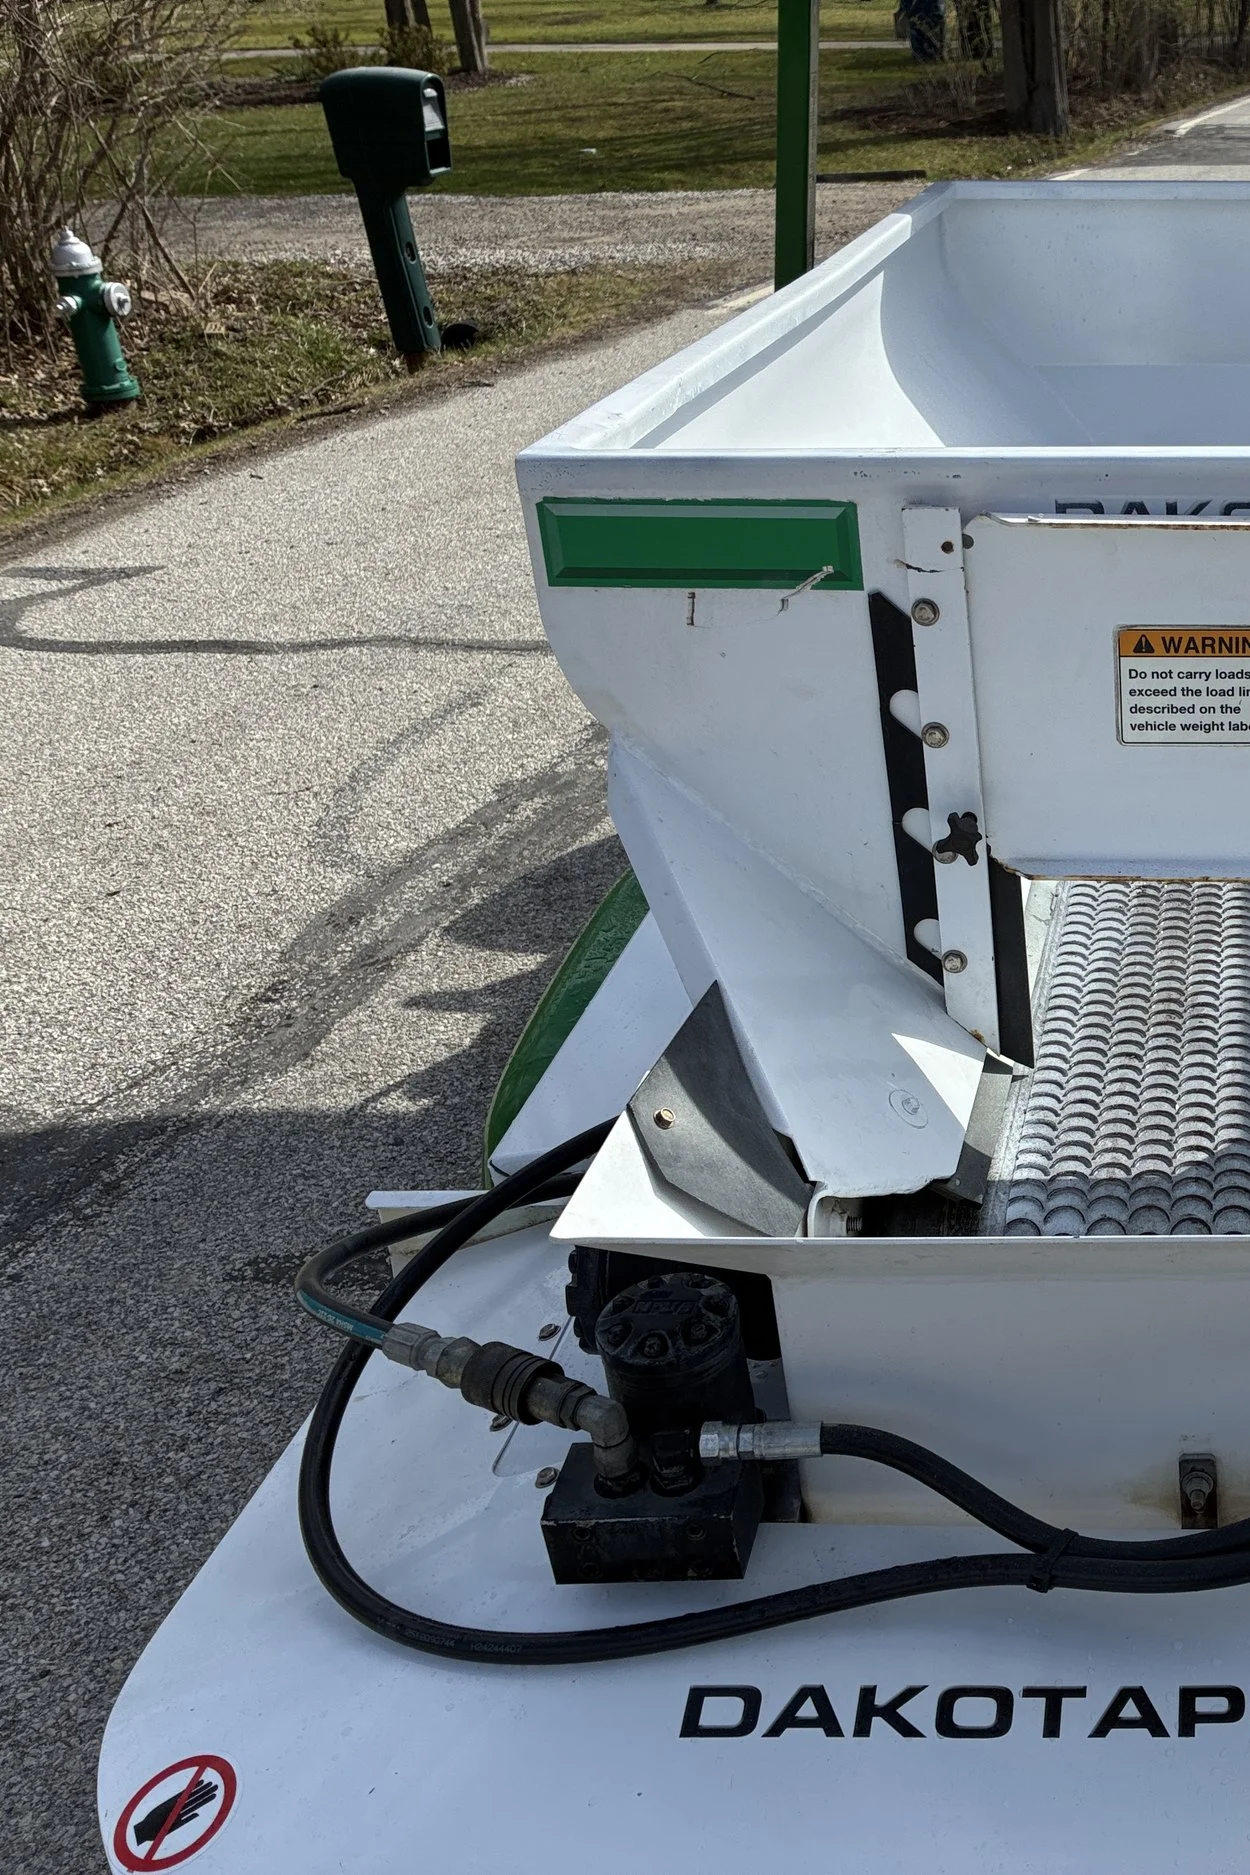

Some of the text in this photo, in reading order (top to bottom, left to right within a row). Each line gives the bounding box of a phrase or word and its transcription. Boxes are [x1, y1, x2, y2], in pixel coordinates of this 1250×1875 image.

[1128, 669, 1147, 680] Do
[1151, 669, 1173, 680] not
[1177, 671, 1212, 682] carry
[1128, 686, 1177, 697] exceed
[1181, 686, 1202, 697] the
[1206, 686, 1235, 697] load
[1129, 704, 1241, 715] described on the
[1129, 721, 1177, 732] vehicle
[1180, 721, 1225, 734] weight
